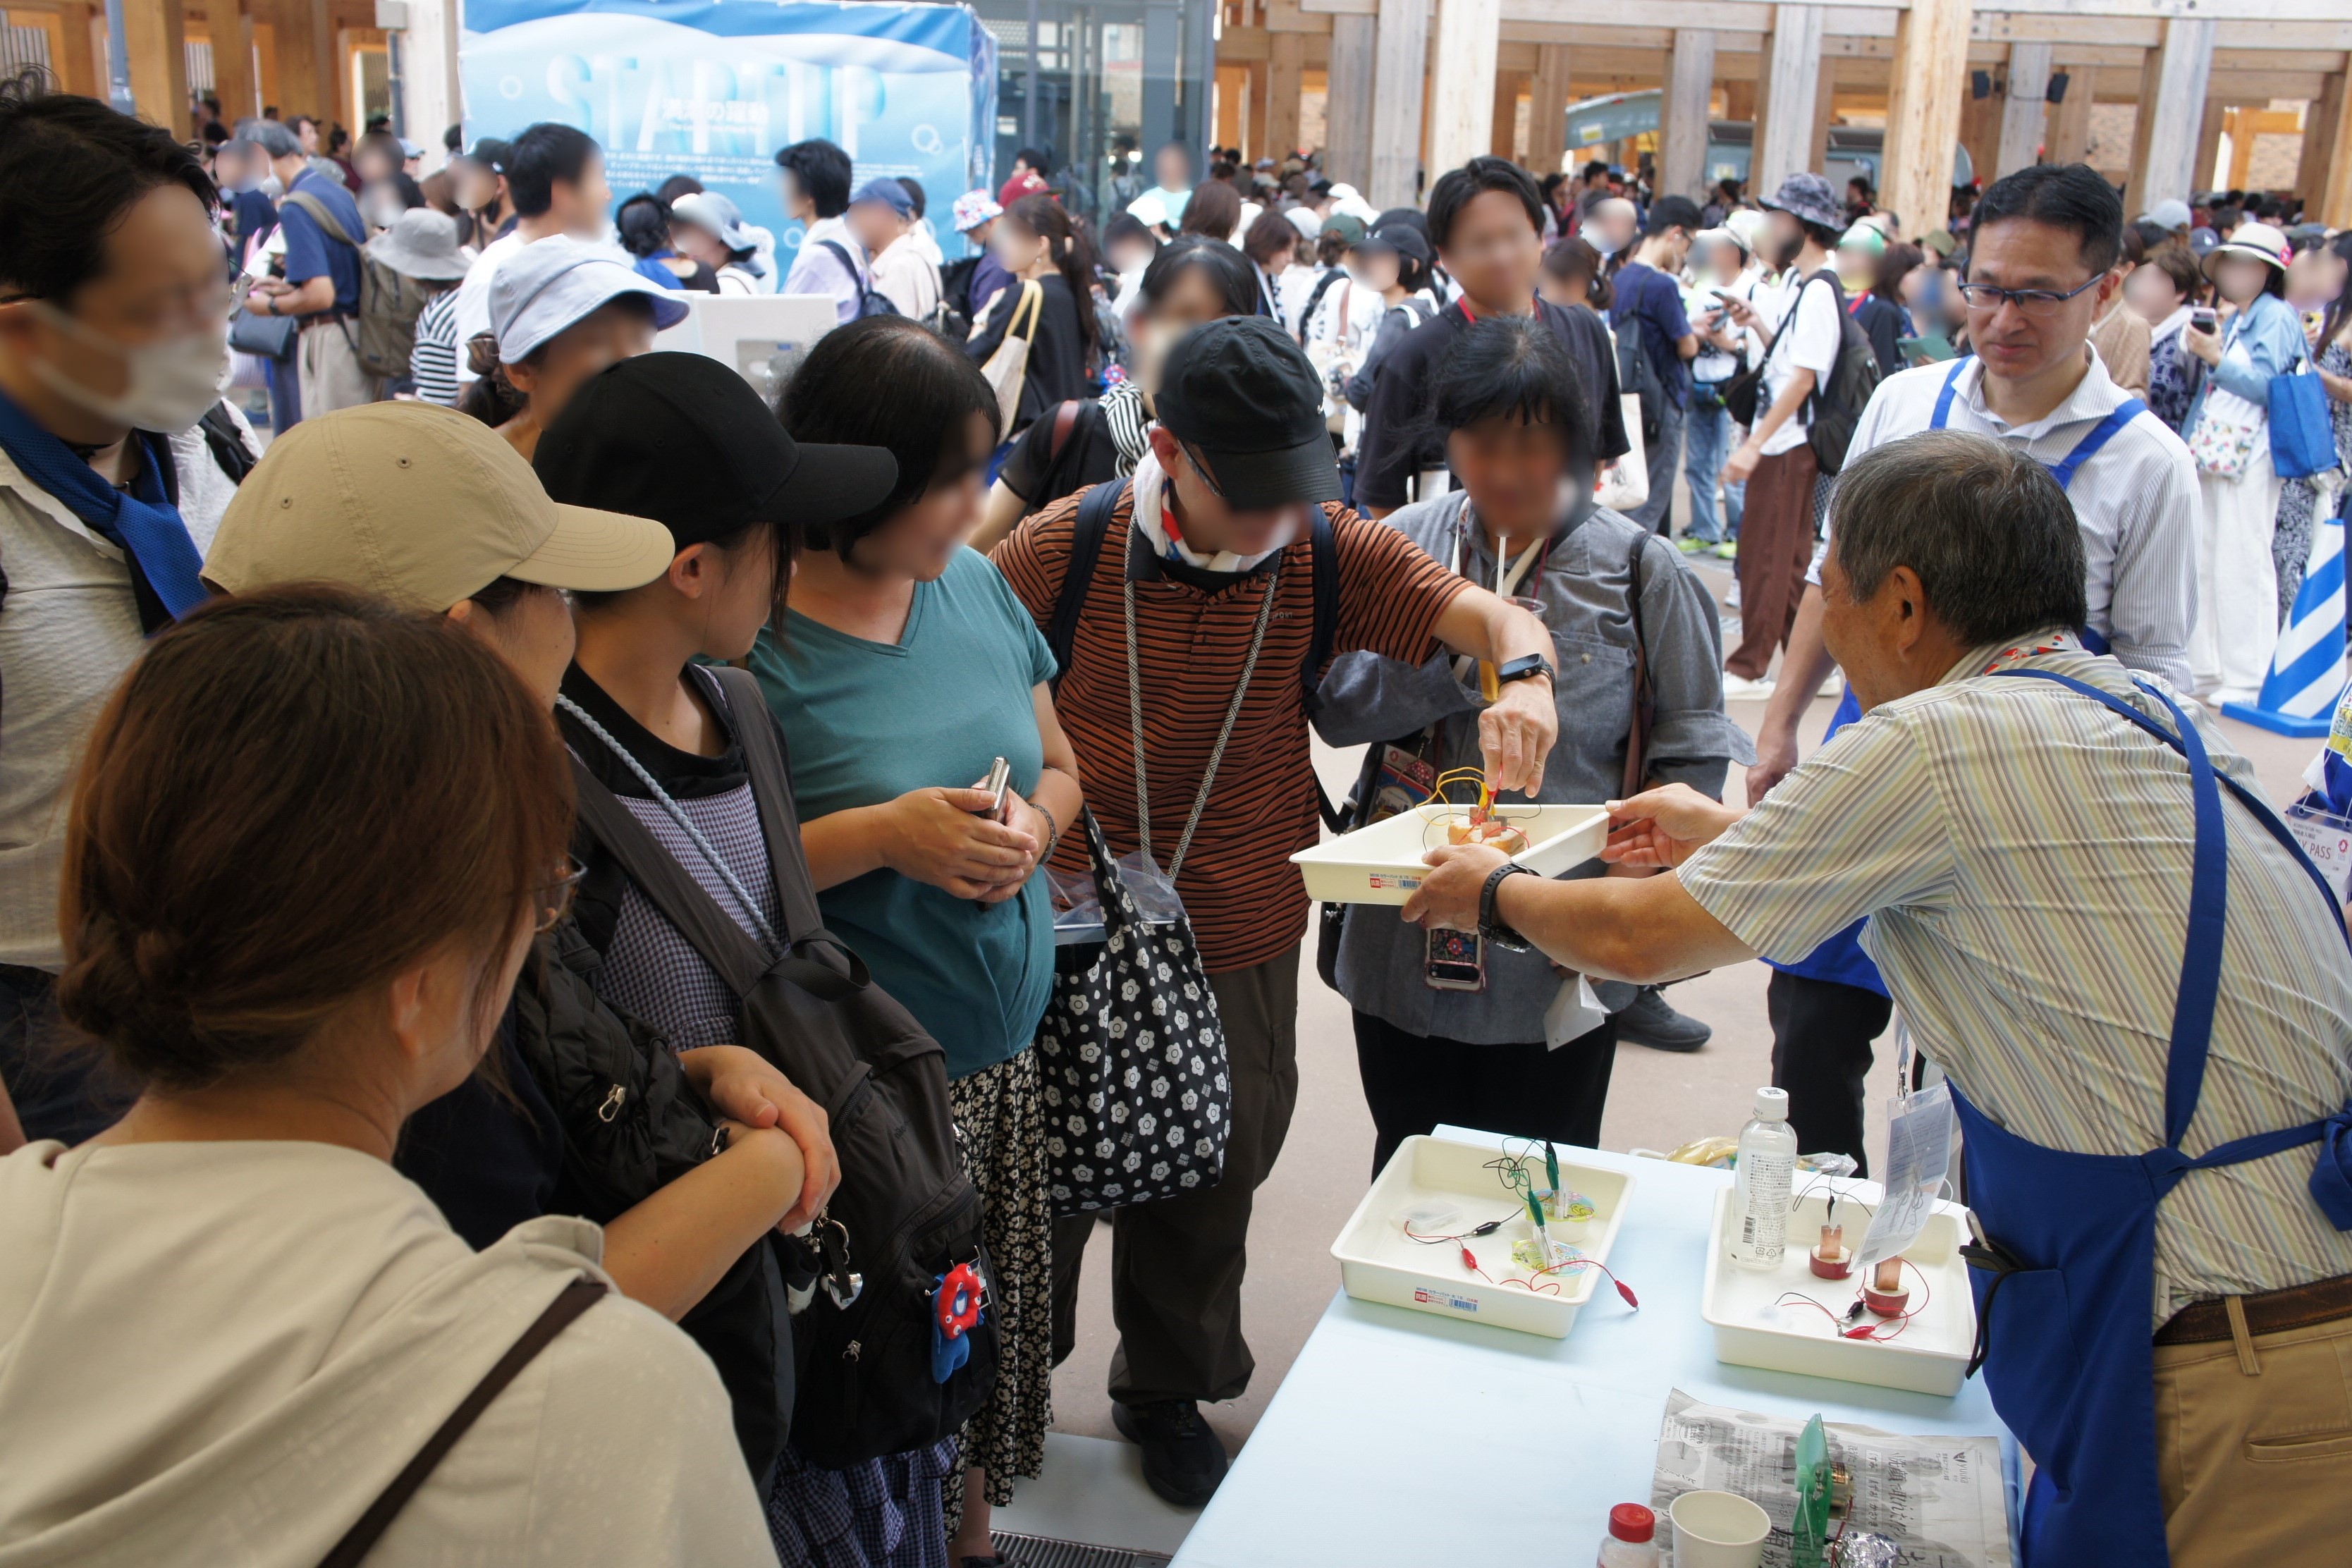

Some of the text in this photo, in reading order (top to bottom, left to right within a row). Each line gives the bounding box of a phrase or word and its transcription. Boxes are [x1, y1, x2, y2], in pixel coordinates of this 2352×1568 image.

[546, 54, 886, 159] STARTUP
[2310, 843, 2332, 859] PASS
[1956, 1463, 1971, 1483] yuuka
